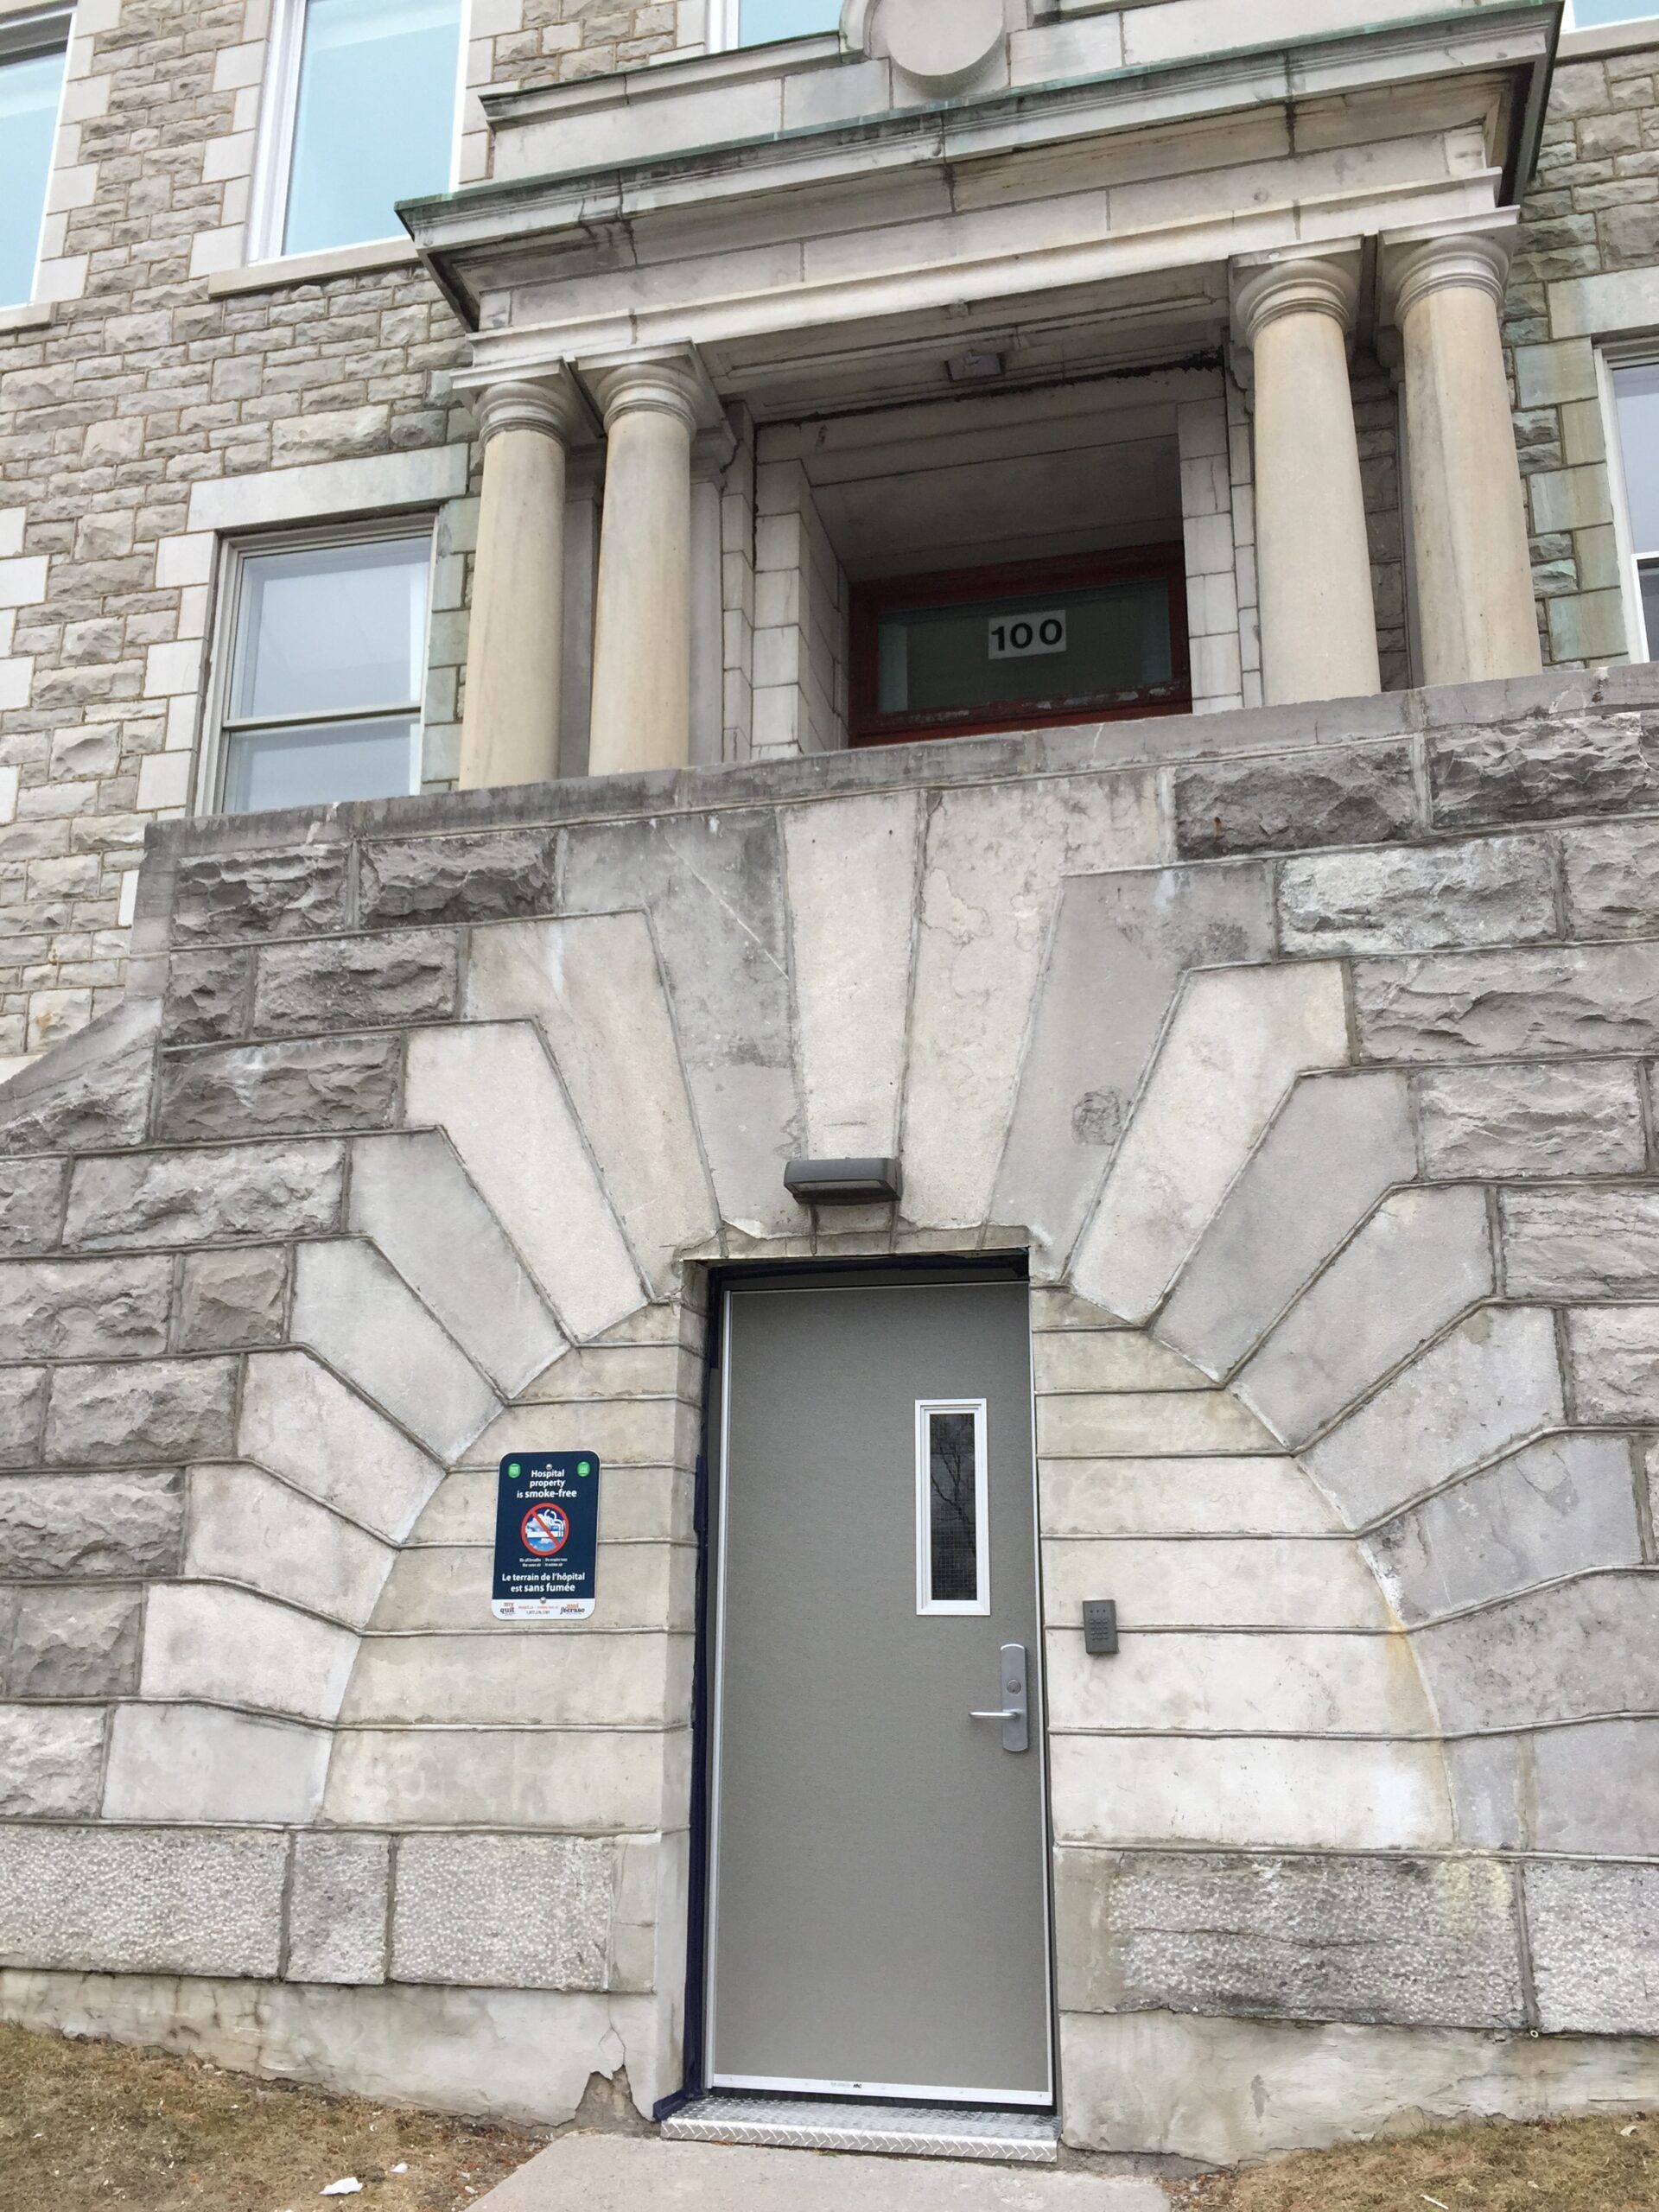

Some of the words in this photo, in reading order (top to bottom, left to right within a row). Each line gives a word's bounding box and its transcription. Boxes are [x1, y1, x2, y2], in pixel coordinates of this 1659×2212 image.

[991, 619, 1063, 652] 100
[531, 1469, 565, 1478] Hospital
[530, 1479, 565, 1489] property
[524, 1488, 577, 1498] smoke-free
[502, 1573, 512, 1581] Le
[512, 1573, 539, 1581] terrain
[540, 1573, 551, 1581] de
[524, 1584, 545, 1592] sans
[546, 1582, 575, 1592] fumée
